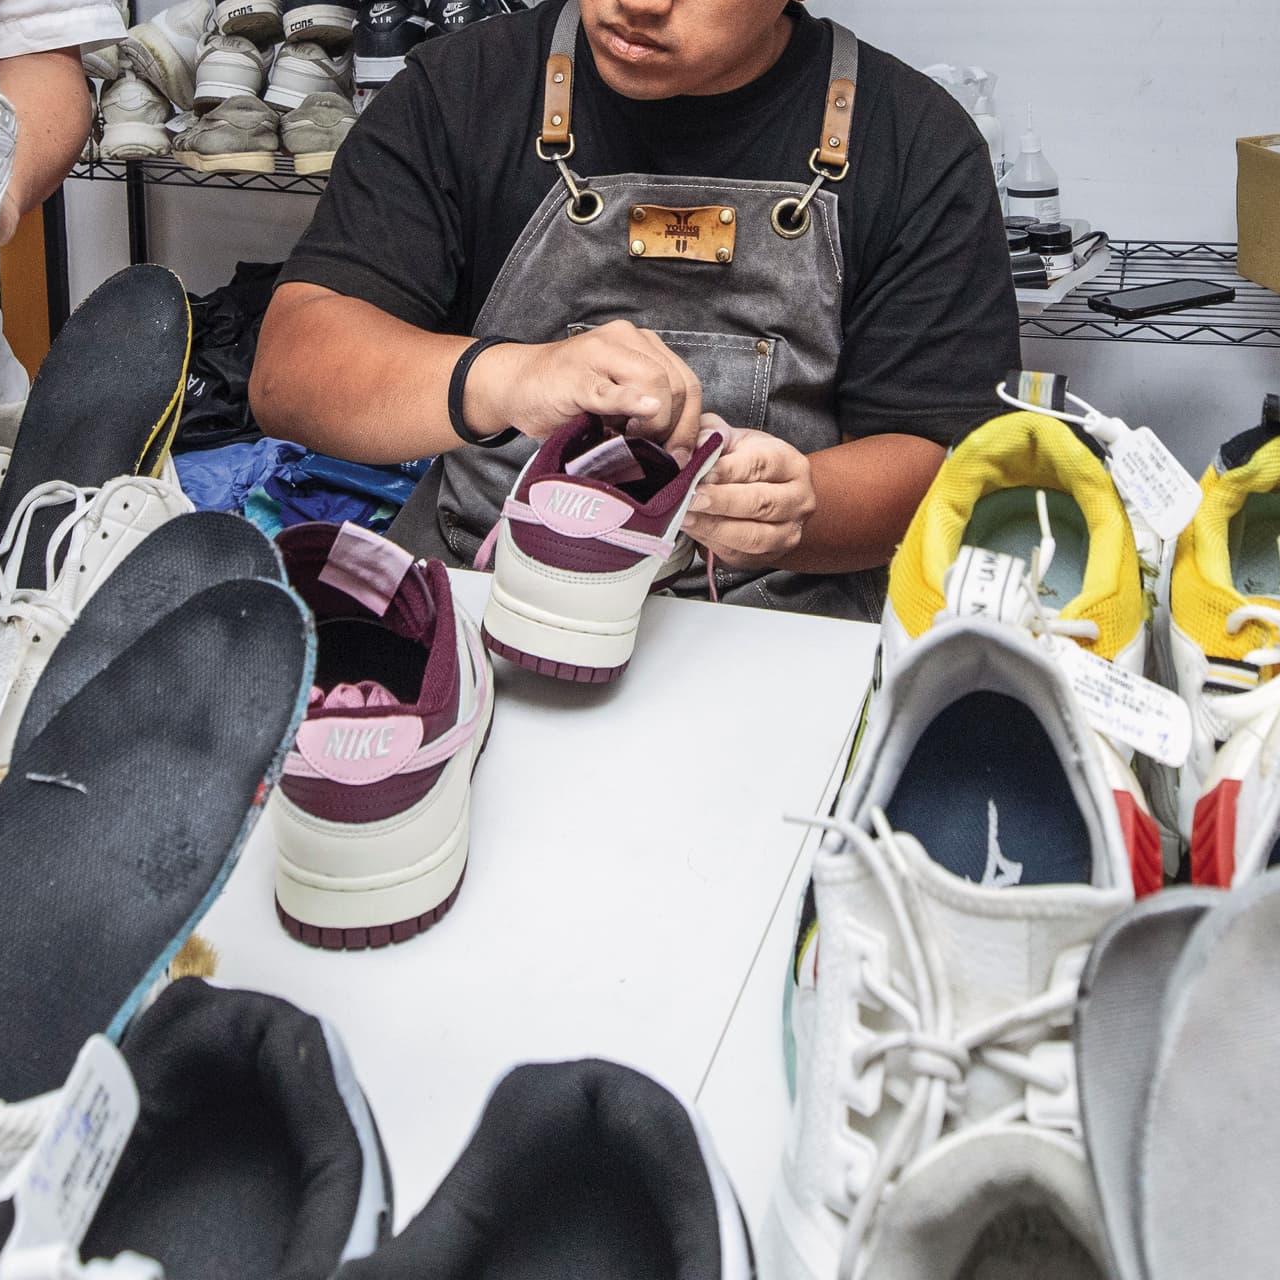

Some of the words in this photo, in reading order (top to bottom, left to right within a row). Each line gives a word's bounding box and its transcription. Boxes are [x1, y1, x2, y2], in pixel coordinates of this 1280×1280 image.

[371, 3, 390, 13] NIKE
[445, 2, 464, 13] NIKE
[371, 16, 393, 24] AIR
[443, 15, 465, 24] AIR
[665, 223, 700, 233] YOUNG
[547, 488, 604, 521] NIKE
[323, 724, 396, 761] NIKE
